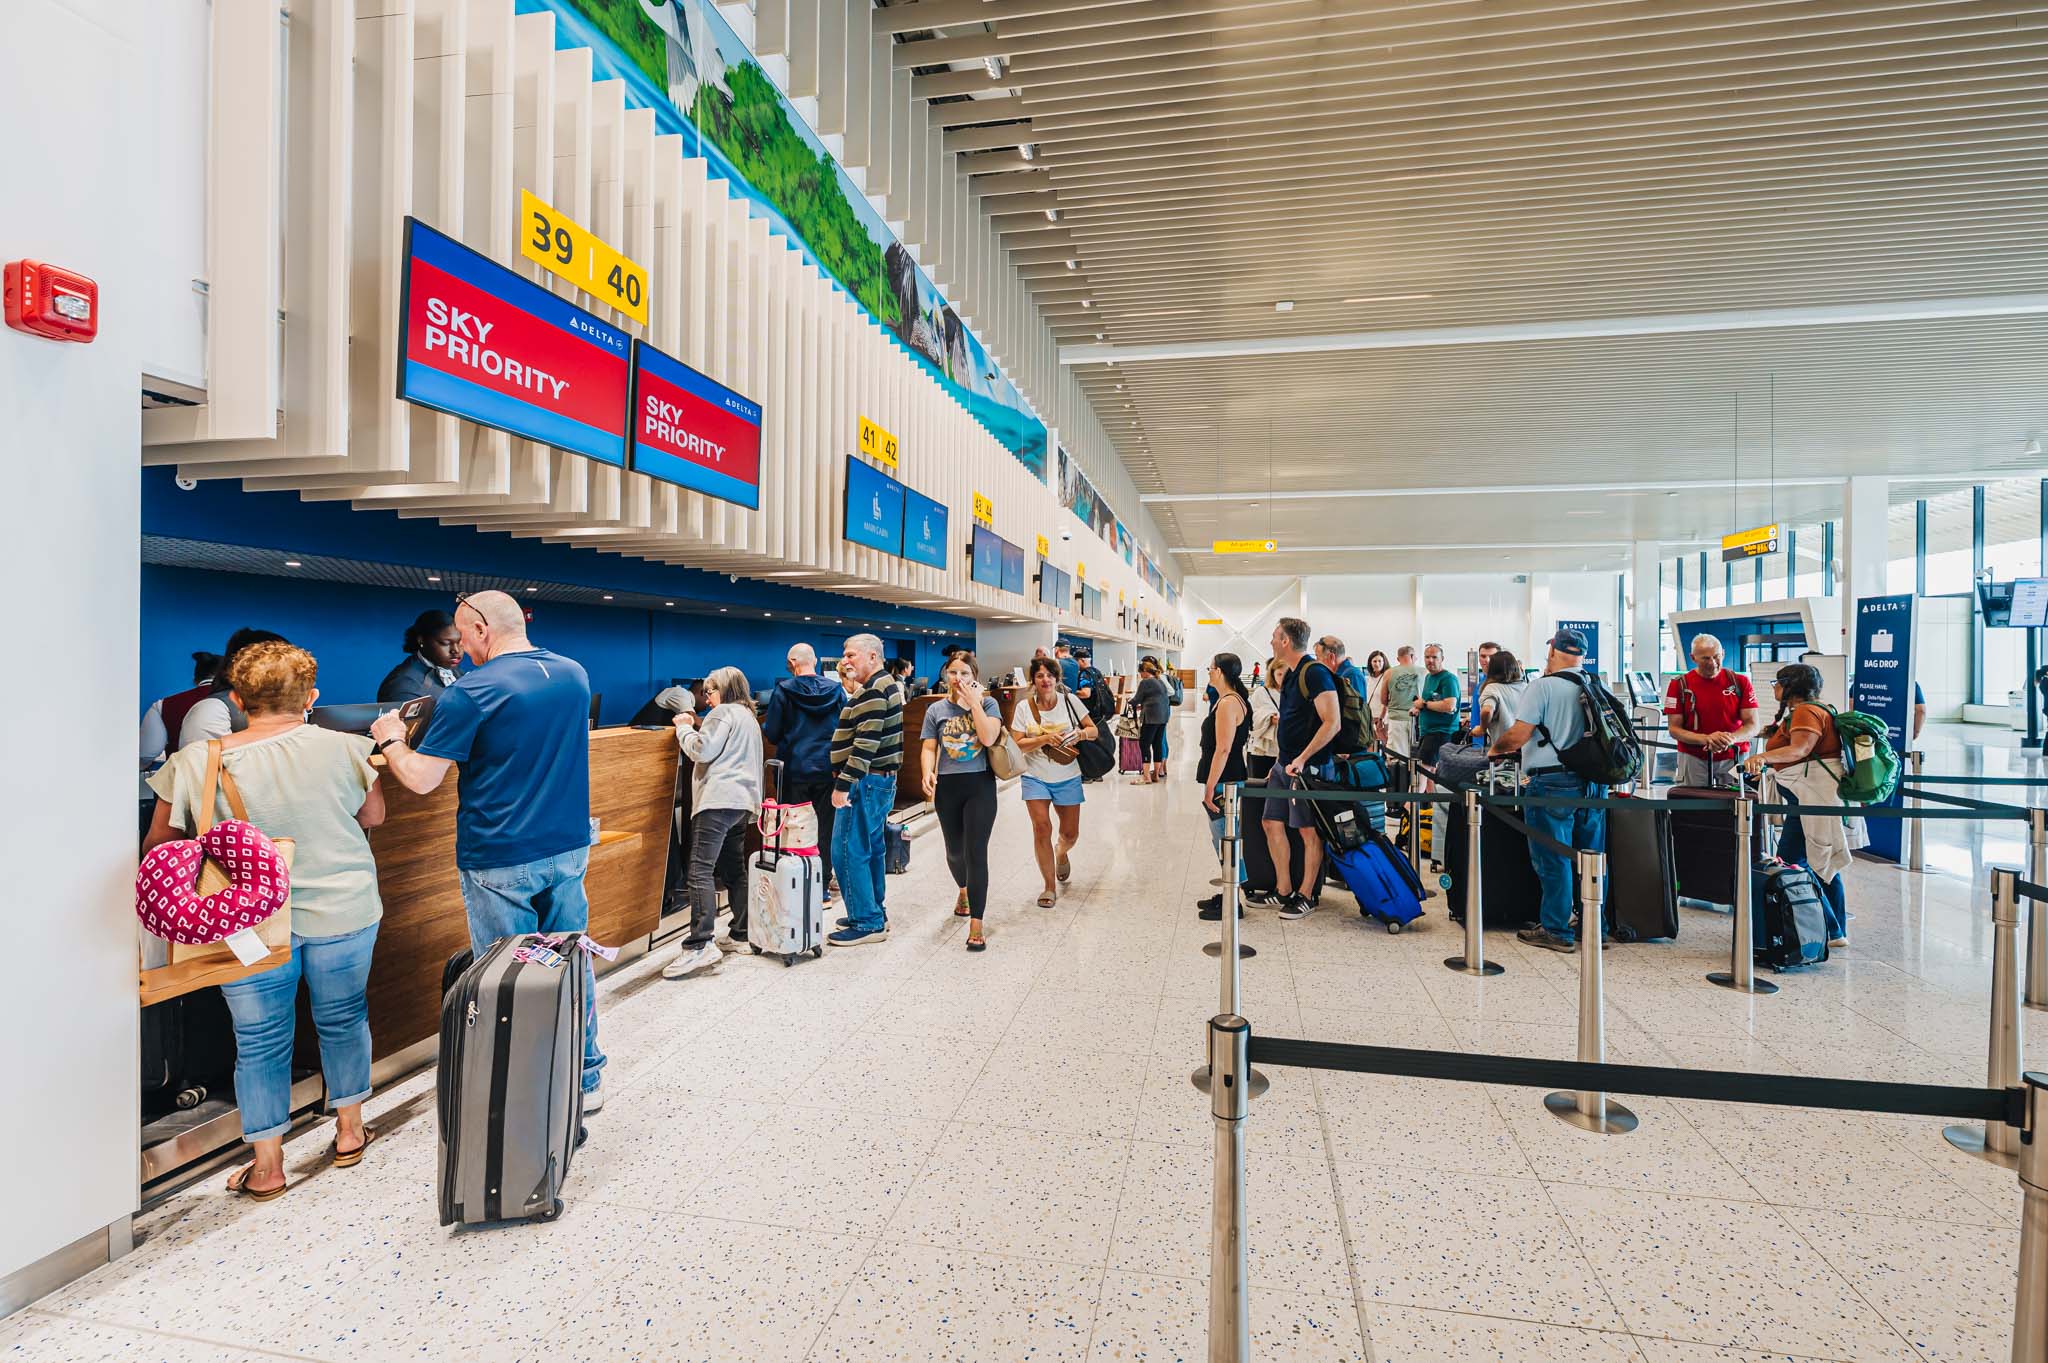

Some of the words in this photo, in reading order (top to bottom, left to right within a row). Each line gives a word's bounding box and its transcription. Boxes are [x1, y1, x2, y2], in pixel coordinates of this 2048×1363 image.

[532, 211, 573, 265] 39
[607, 264, 641, 307] 40
[426, 297, 493, 344] SKY
[581, 322, 614, 346] DELTA
[425, 325, 569, 400] PRIORITY
[646, 395, 683, 426] SKY
[731, 401, 752, 416] DELTA
[645, 416, 724, 462] PRIORITY
[863, 425, 875, 449] 41
[886, 440, 896, 461] 42
[1870, 602, 1898, 612] DELTA
[1864, 659, 1878, 668] BAG
[1879, 659, 1899, 669] DROP
